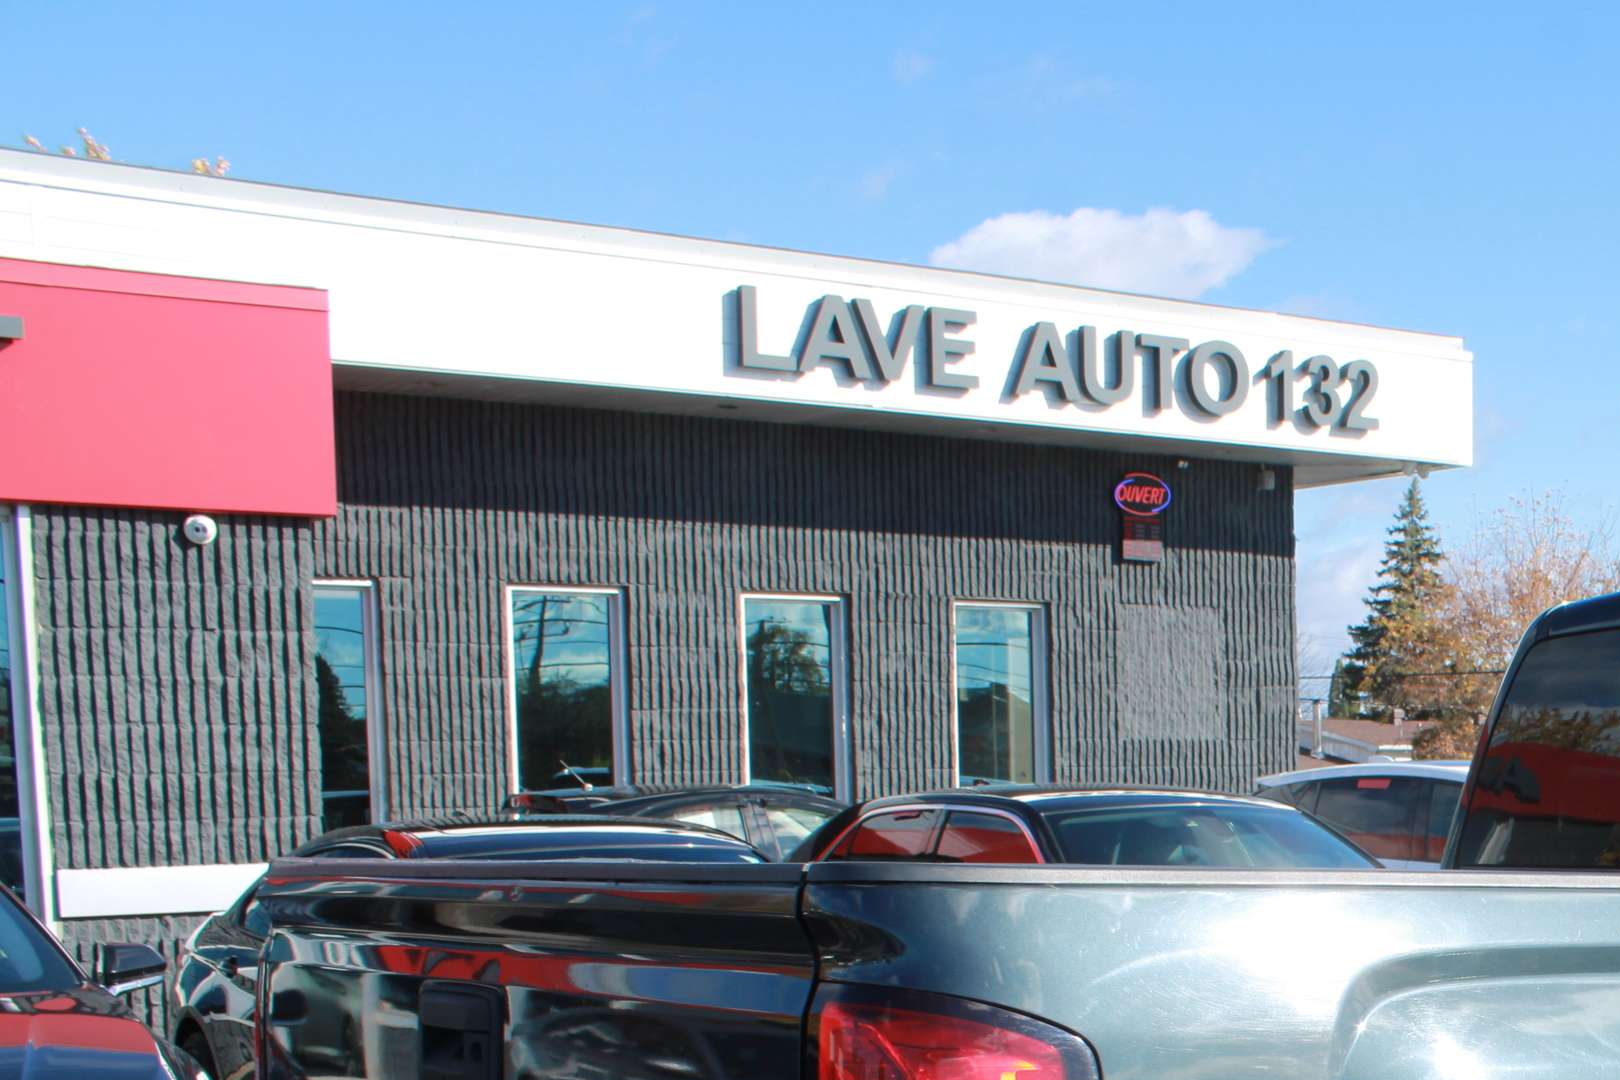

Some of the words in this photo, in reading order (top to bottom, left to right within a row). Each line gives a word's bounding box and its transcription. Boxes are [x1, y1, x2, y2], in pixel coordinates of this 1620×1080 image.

[723, 285, 979, 390] LAVE
[1000, 321, 1250, 424] AUTO
[1252, 350, 1380, 438] 132
[1117, 485, 1166, 505] OUVERT
